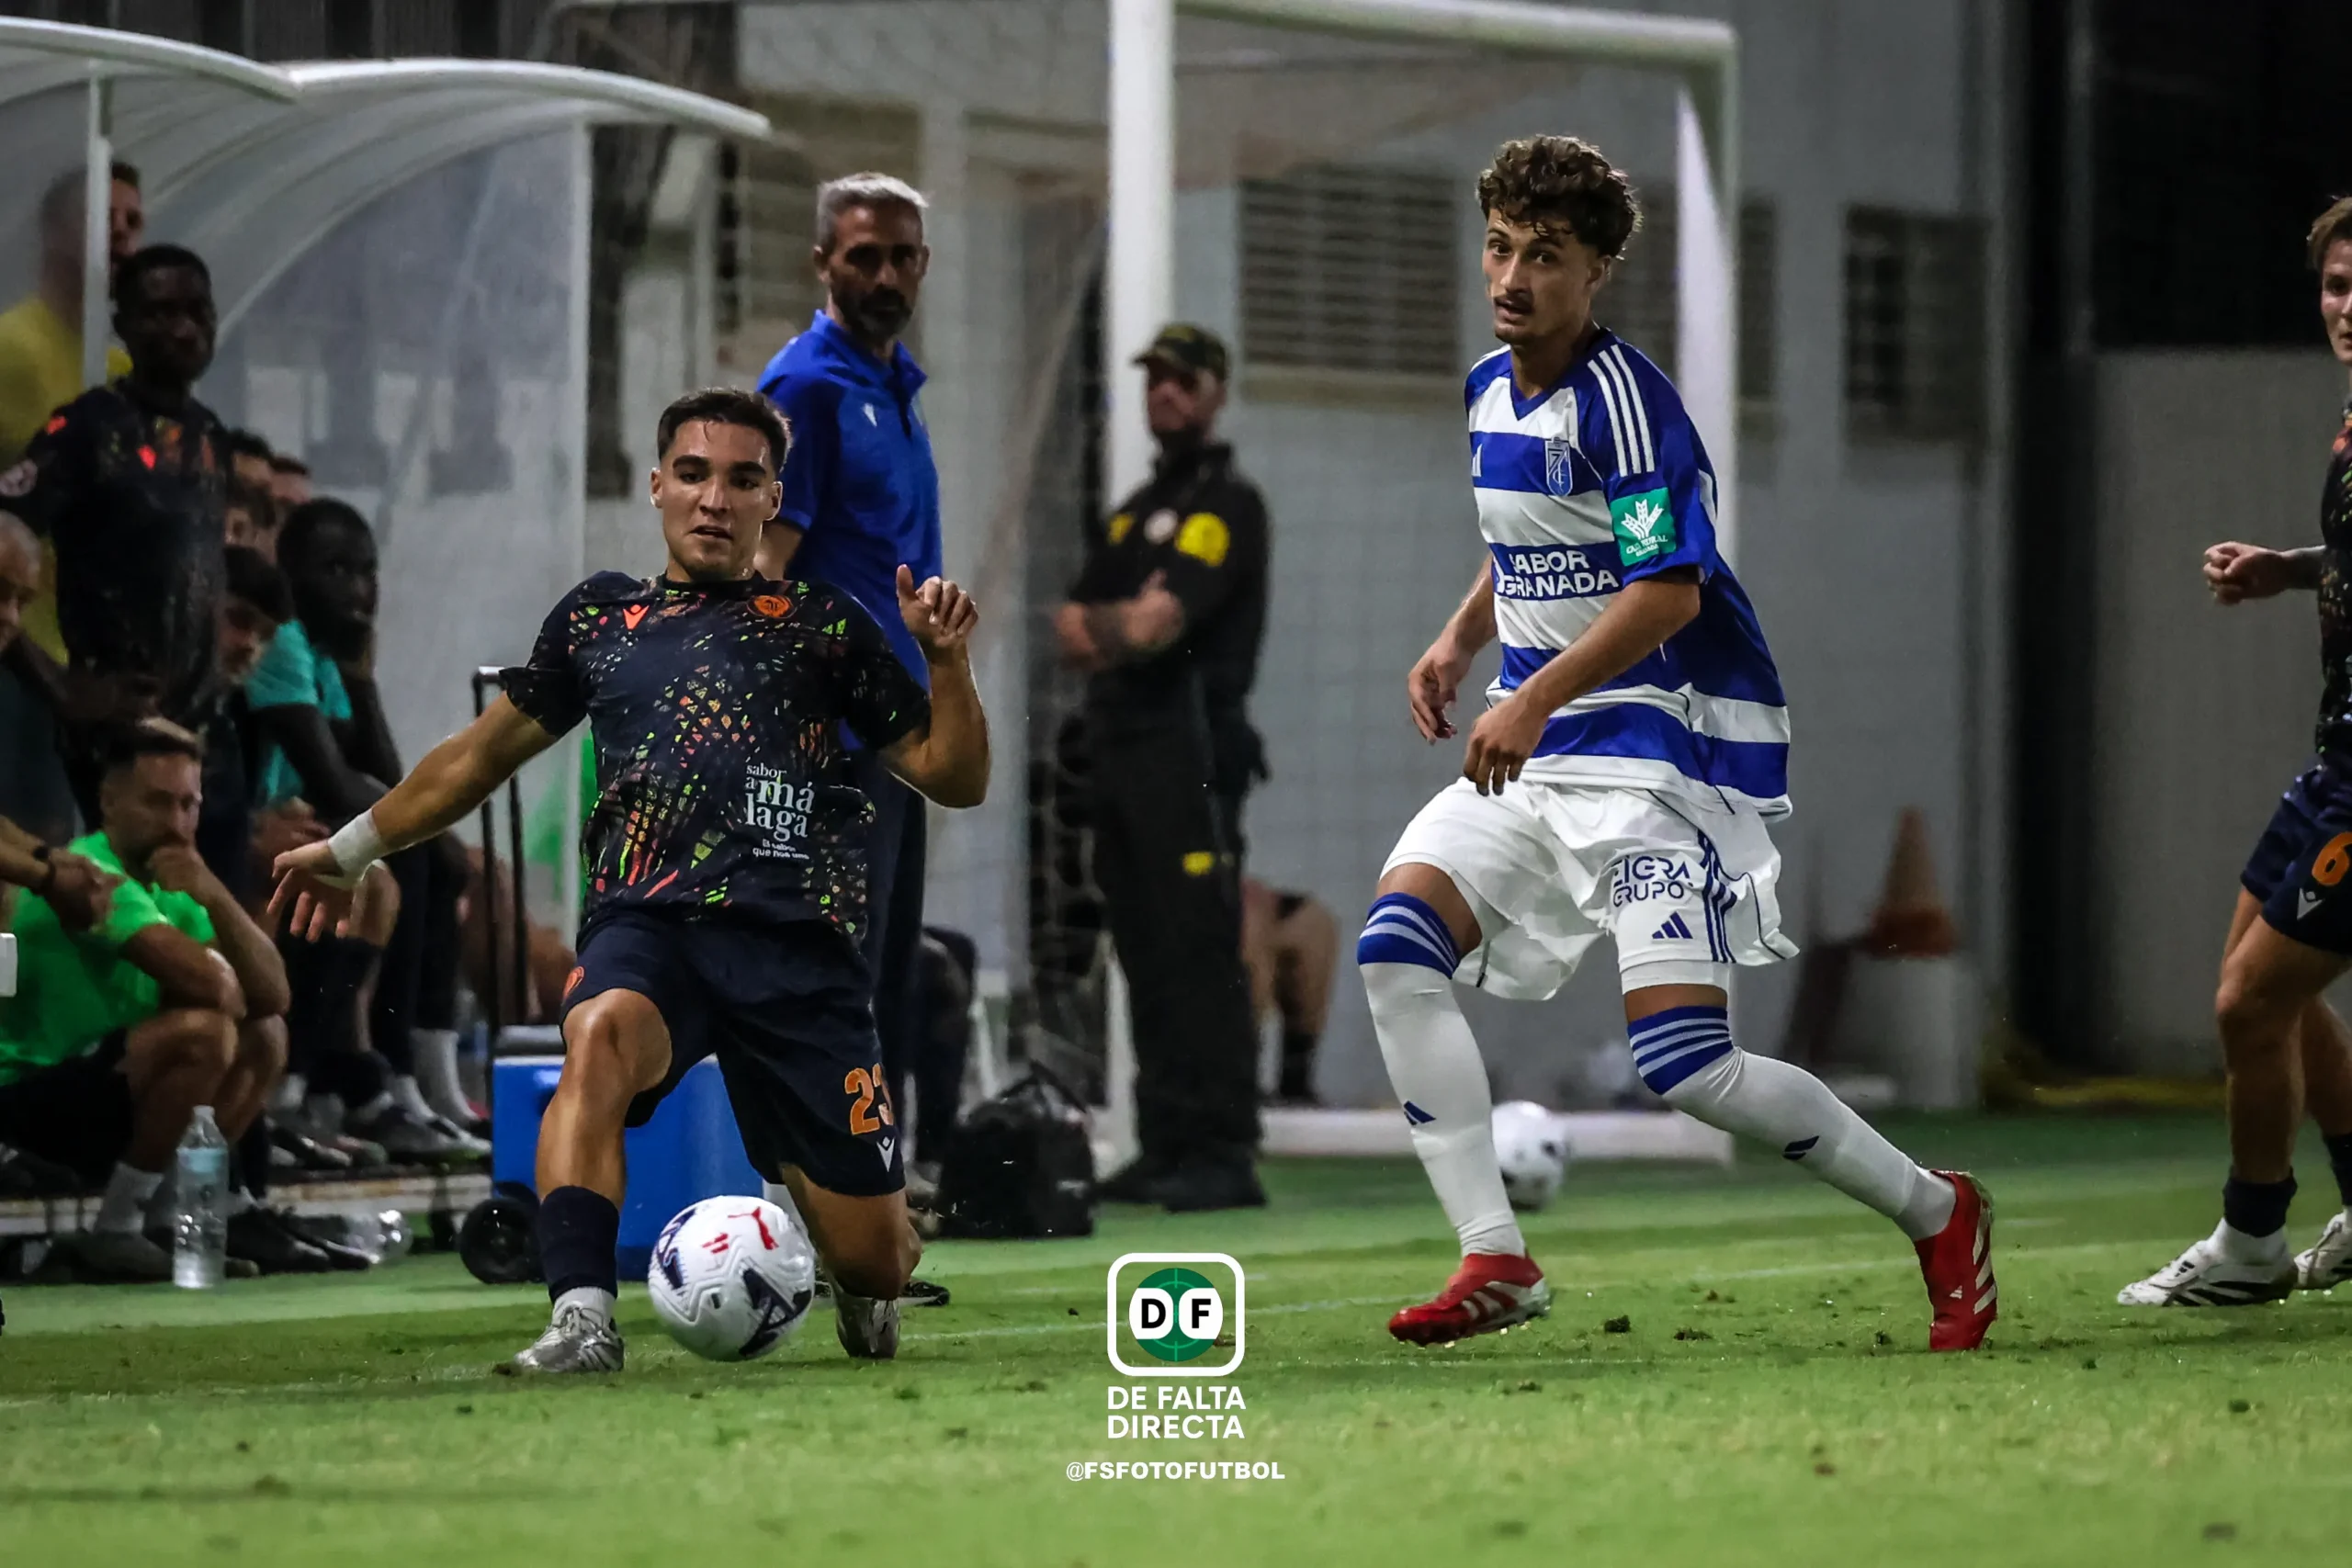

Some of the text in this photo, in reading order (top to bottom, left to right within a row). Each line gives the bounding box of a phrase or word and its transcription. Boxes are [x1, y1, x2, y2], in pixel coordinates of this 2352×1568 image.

[1503, 570, 1619, 597] GRANADA
[745, 776, 756, 789] a
[746, 762, 787, 779] sabor
[745, 793, 808, 841] laga
[2312, 831, 2352, 886] 6
[1613, 881, 1684, 908] GRUPO
